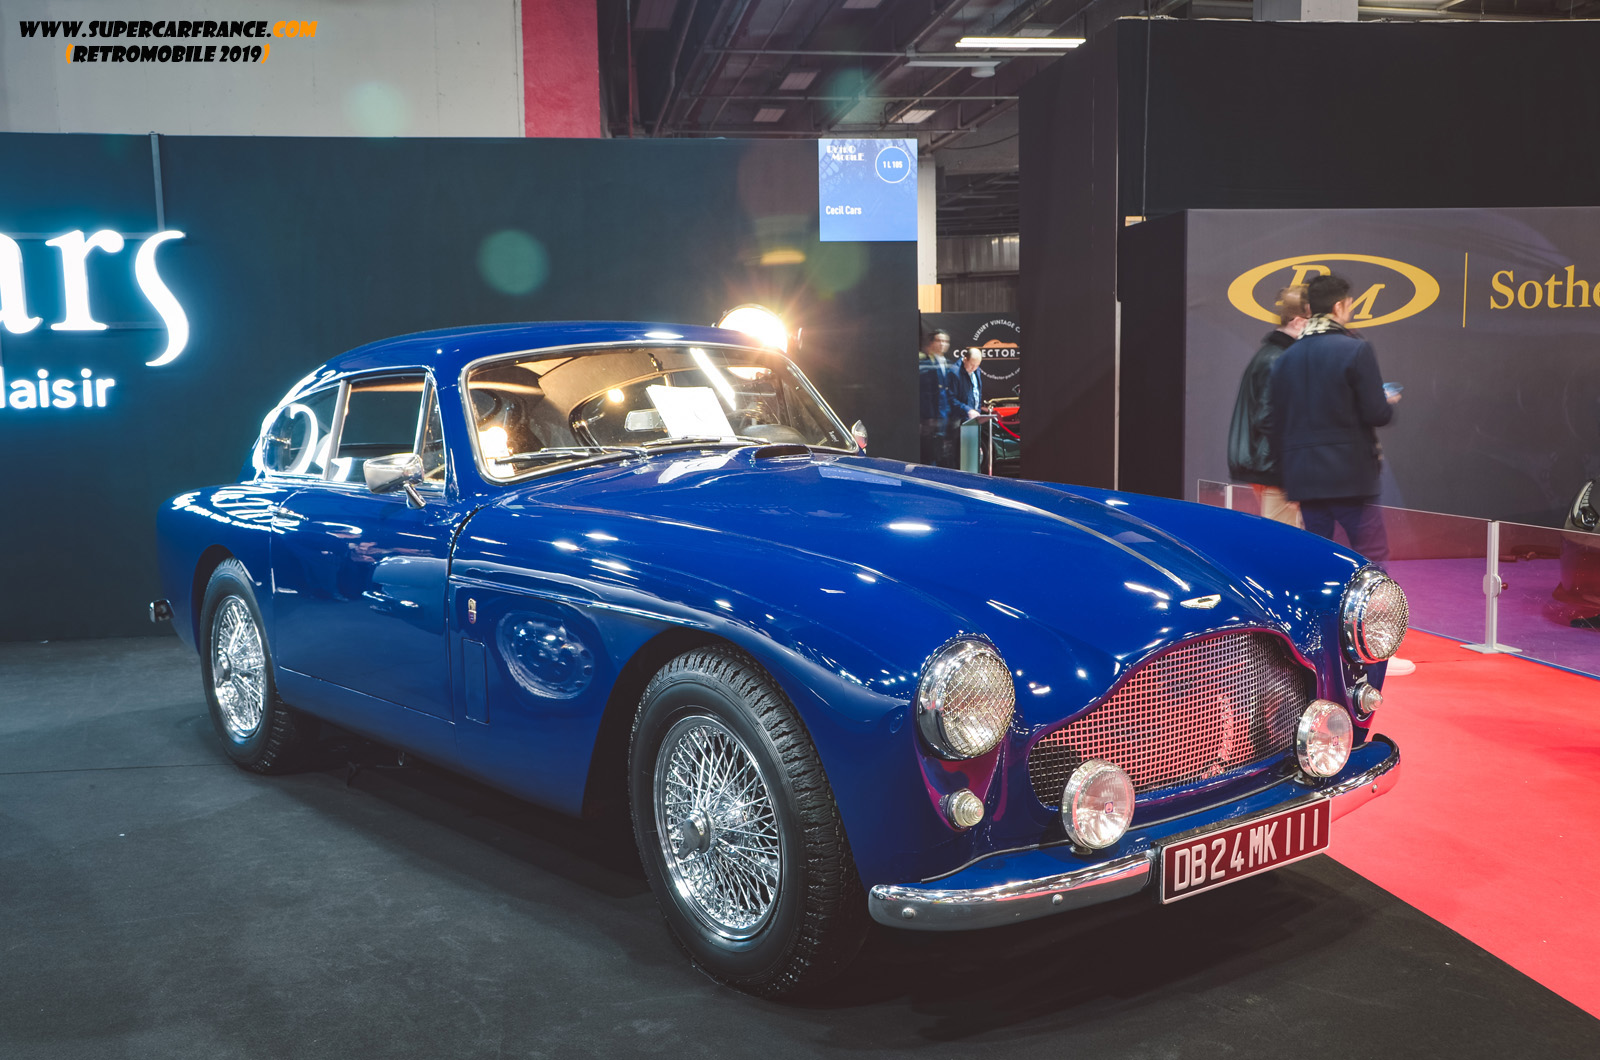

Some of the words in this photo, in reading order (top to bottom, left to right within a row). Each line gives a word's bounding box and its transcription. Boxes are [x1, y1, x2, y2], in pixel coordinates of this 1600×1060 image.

[825, 205, 845, 215] Cecil
[845, 205, 863, 215] Cars
[972, 322, 989, 341] LUXURY
[989, 319, 1016, 329] VINTAGE
